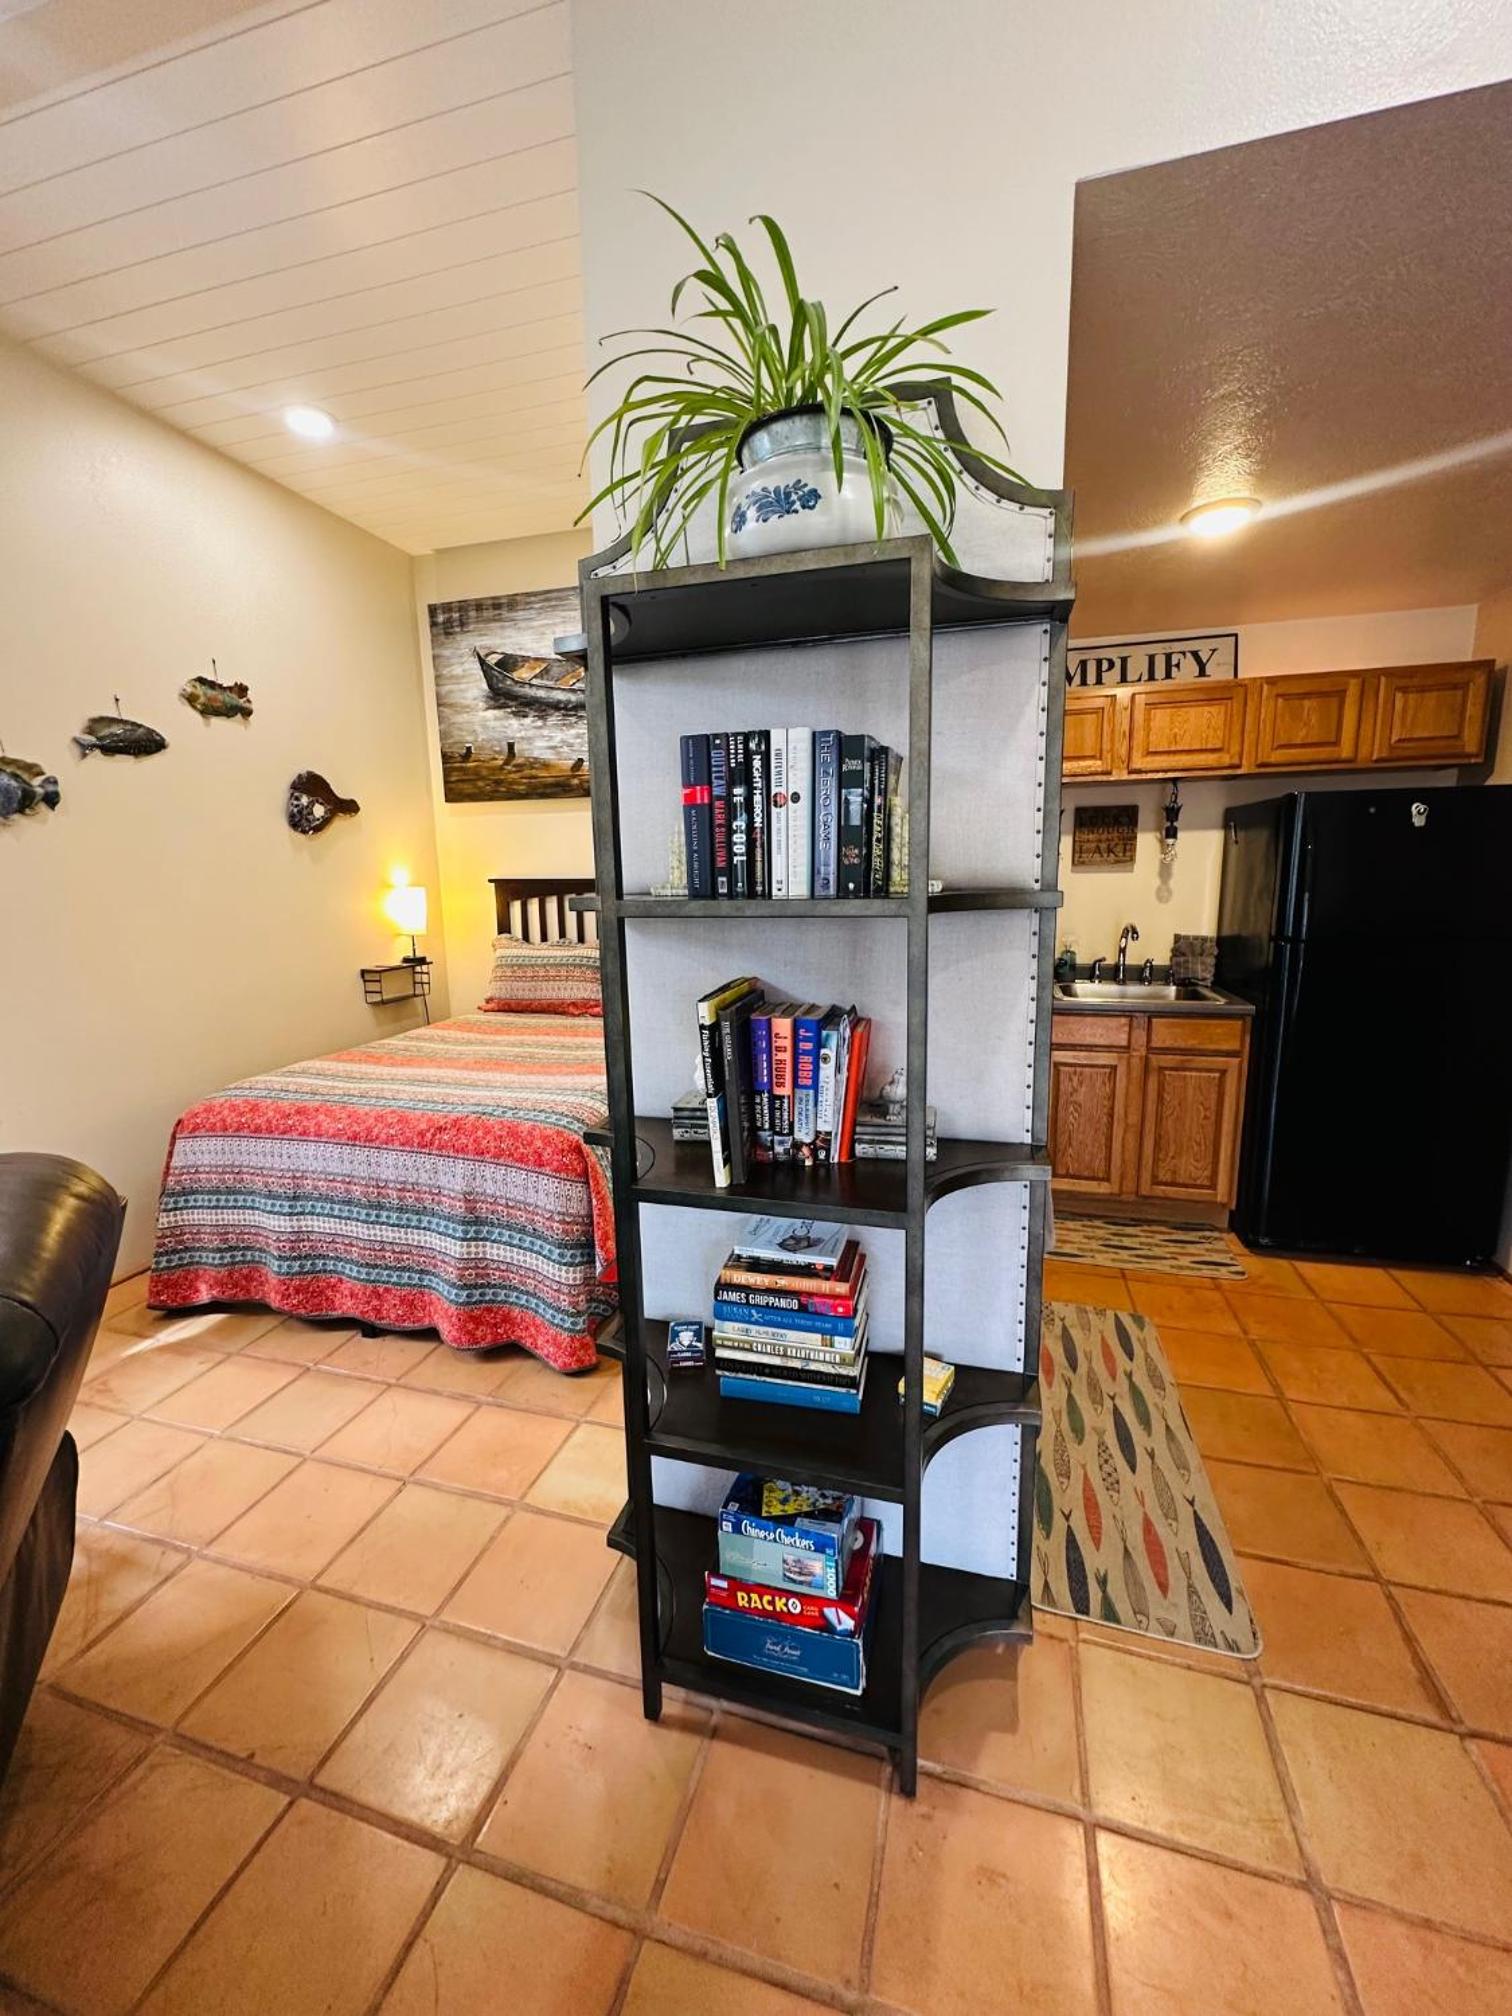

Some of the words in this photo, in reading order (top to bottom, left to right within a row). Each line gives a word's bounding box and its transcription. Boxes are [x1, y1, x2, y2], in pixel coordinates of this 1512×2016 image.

[1066, 648, 1218, 688] MPLIFY
[820, 733, 833, 762] THE
[711, 749, 727, 796] OUTLAW
[752, 754, 762, 788] NIGHT
[820, 766, 833, 807] ZERO
[713, 800, 726, 825] MARK
[752, 789, 763, 828] HERON
[733, 820, 746, 865] COOL
[818, 811, 833, 851] GAME
[714, 827, 728, 869] SULLIVAN
[797, 1055, 813, 1087] ROBB
[733, 1273, 770, 1286] DEWEY
[716, 1289, 747, 1304] JAMES
[749, 1293, 799, 1310] GRIPPANDO
[722, 1305, 749, 1315] SUSAN
[752, 1342, 784, 1355] CHARLES
[741, 1519, 775, 1541] Chinese
[775, 1528, 815, 1551] Checkers
